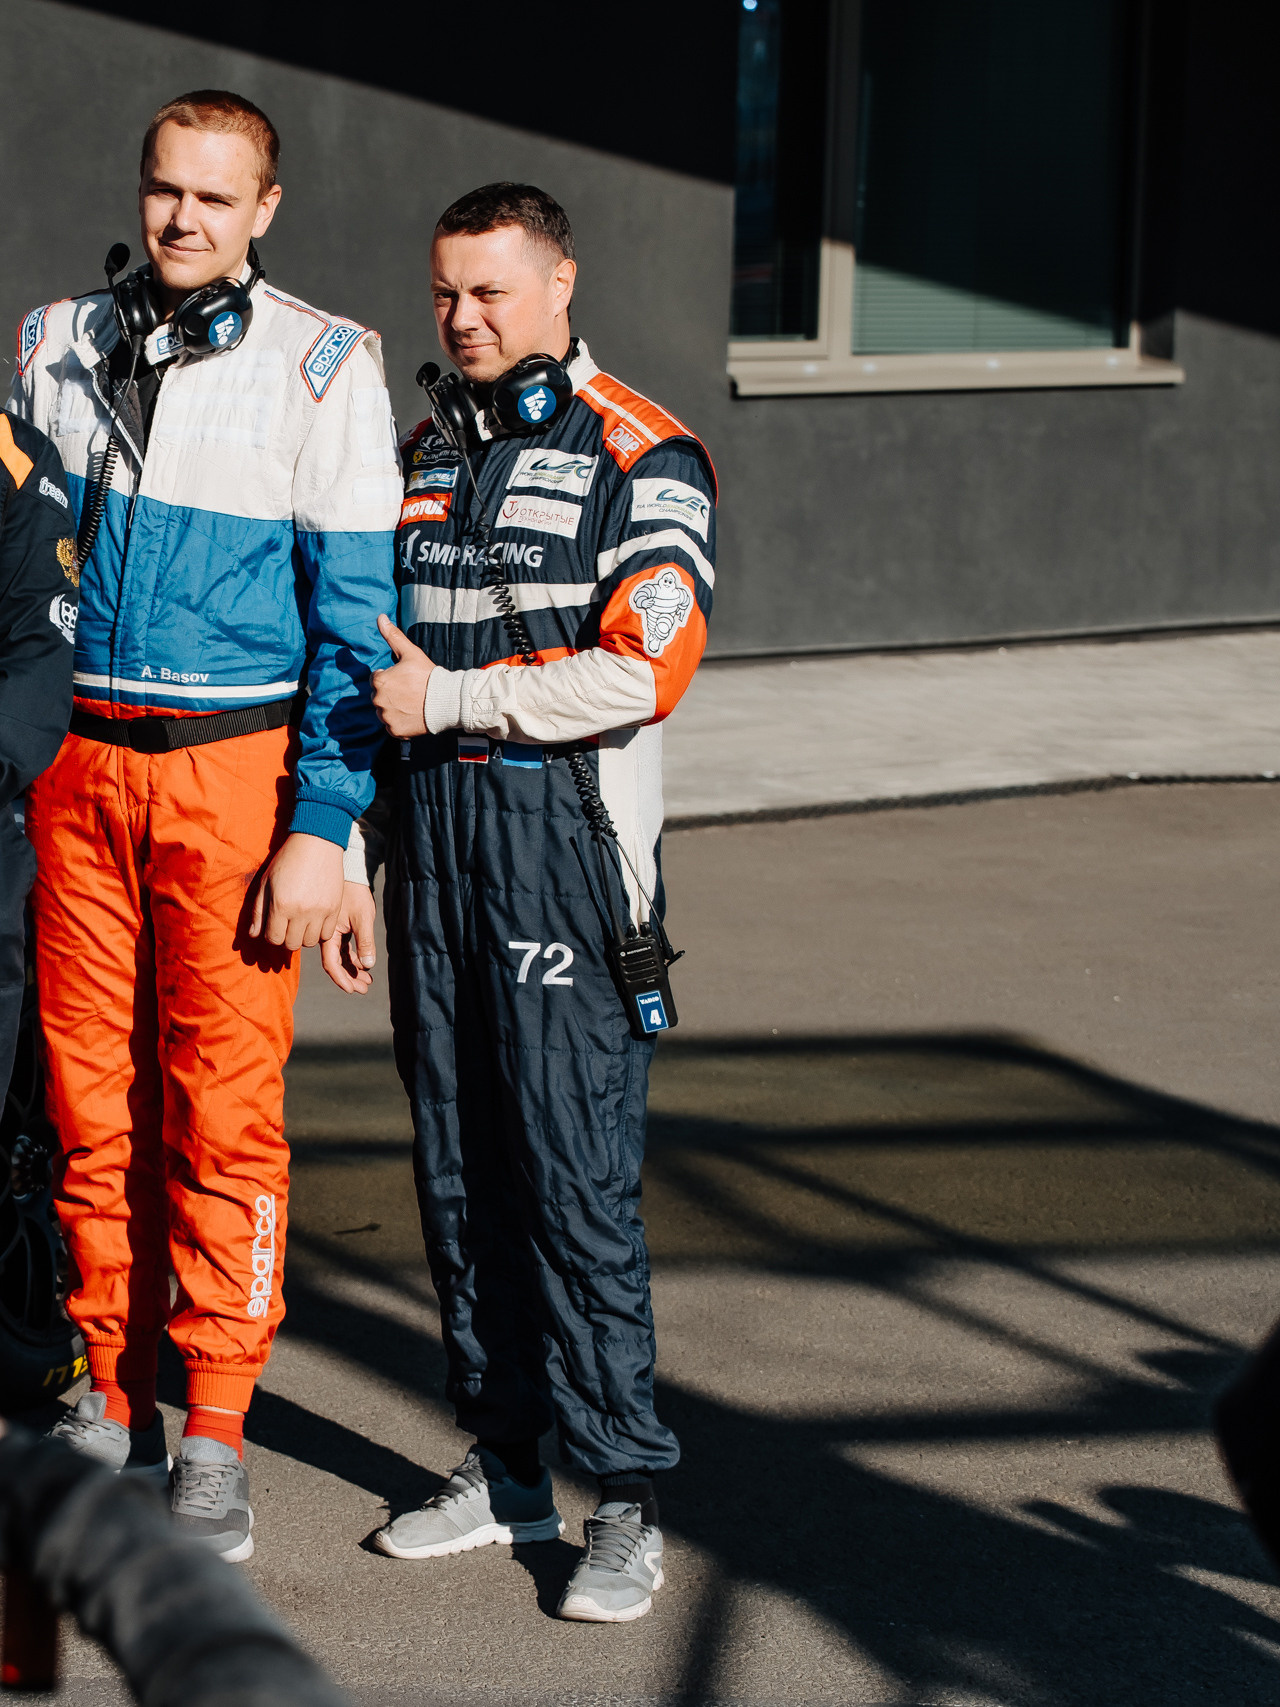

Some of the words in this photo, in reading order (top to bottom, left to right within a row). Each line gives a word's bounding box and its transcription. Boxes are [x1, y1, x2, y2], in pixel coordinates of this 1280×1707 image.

[312, 327, 351, 373] sparco
[609, 428, 640, 452] OMP
[401, 500, 445, 521] MOTUL
[141, 665, 157, 680] A.
[160, 667, 209, 683] Basov
[508, 940, 574, 987] 72
[650, 1008, 662, 1026] 4
[247, 1194, 274, 1318] sparco
